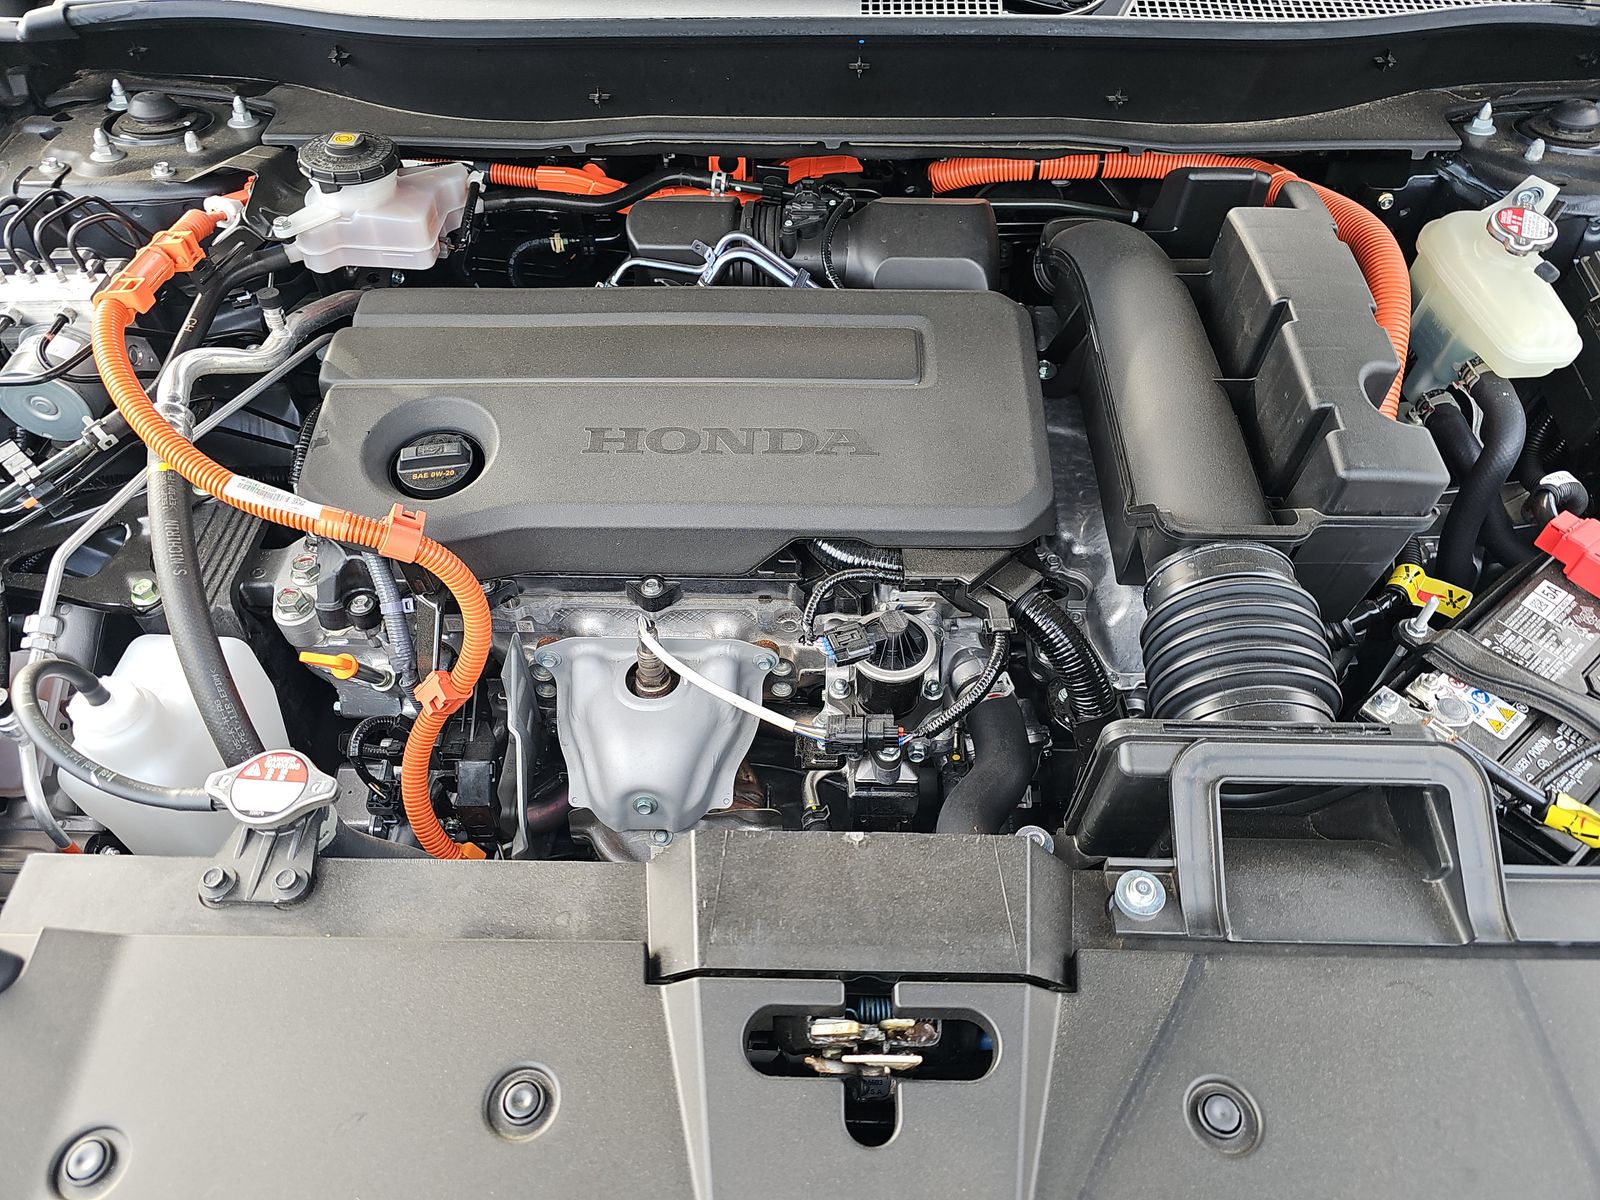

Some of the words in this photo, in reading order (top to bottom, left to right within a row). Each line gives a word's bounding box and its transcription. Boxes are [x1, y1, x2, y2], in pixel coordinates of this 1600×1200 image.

[581, 426, 880, 456] HONDA
[412, 472, 429, 480] SAE
[430, 469, 455, 479] 0W-20
[1541, 585, 1562, 600] 5A
